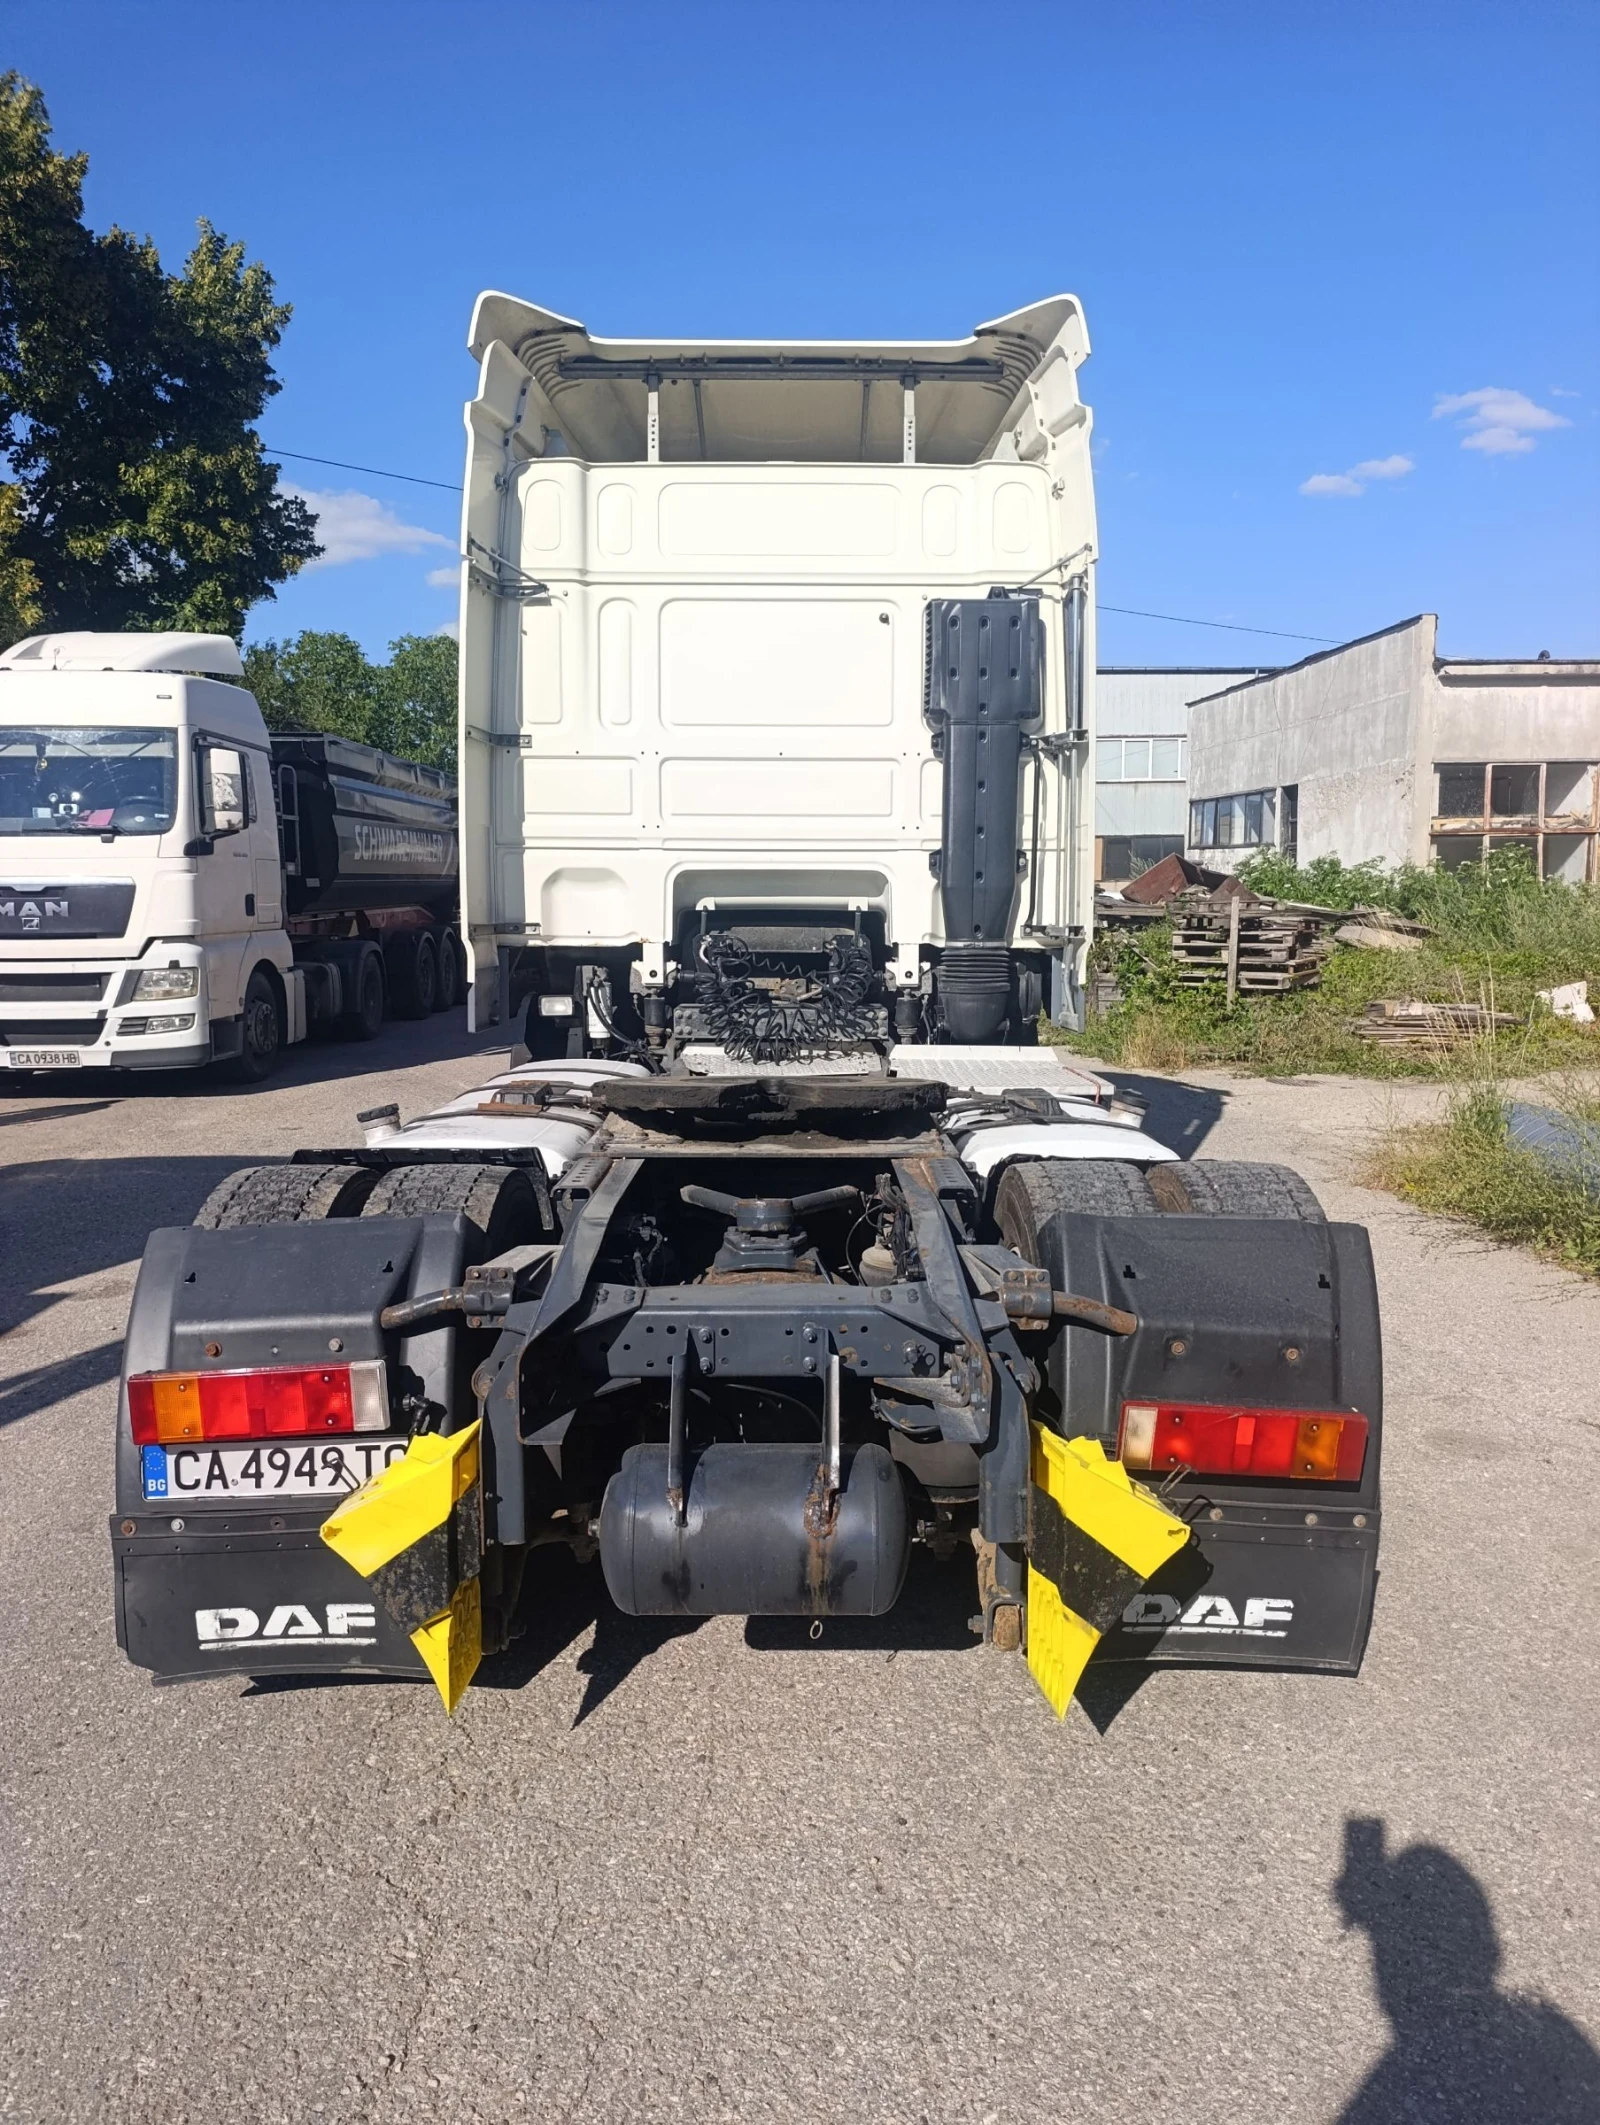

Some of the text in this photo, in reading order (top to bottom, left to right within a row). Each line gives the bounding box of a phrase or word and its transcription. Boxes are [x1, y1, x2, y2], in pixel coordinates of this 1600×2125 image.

[0, 901, 69, 917] MAN
[17, 1053, 77, 1064] CA 0938 HB
[174, 1450, 230, 1490] CA
[240, 1447, 344, 1489] 4949
[147, 1479, 166, 1491] BG
[195, 1603, 376, 1641] DAF
[1122, 1593, 1294, 1627] DAF
